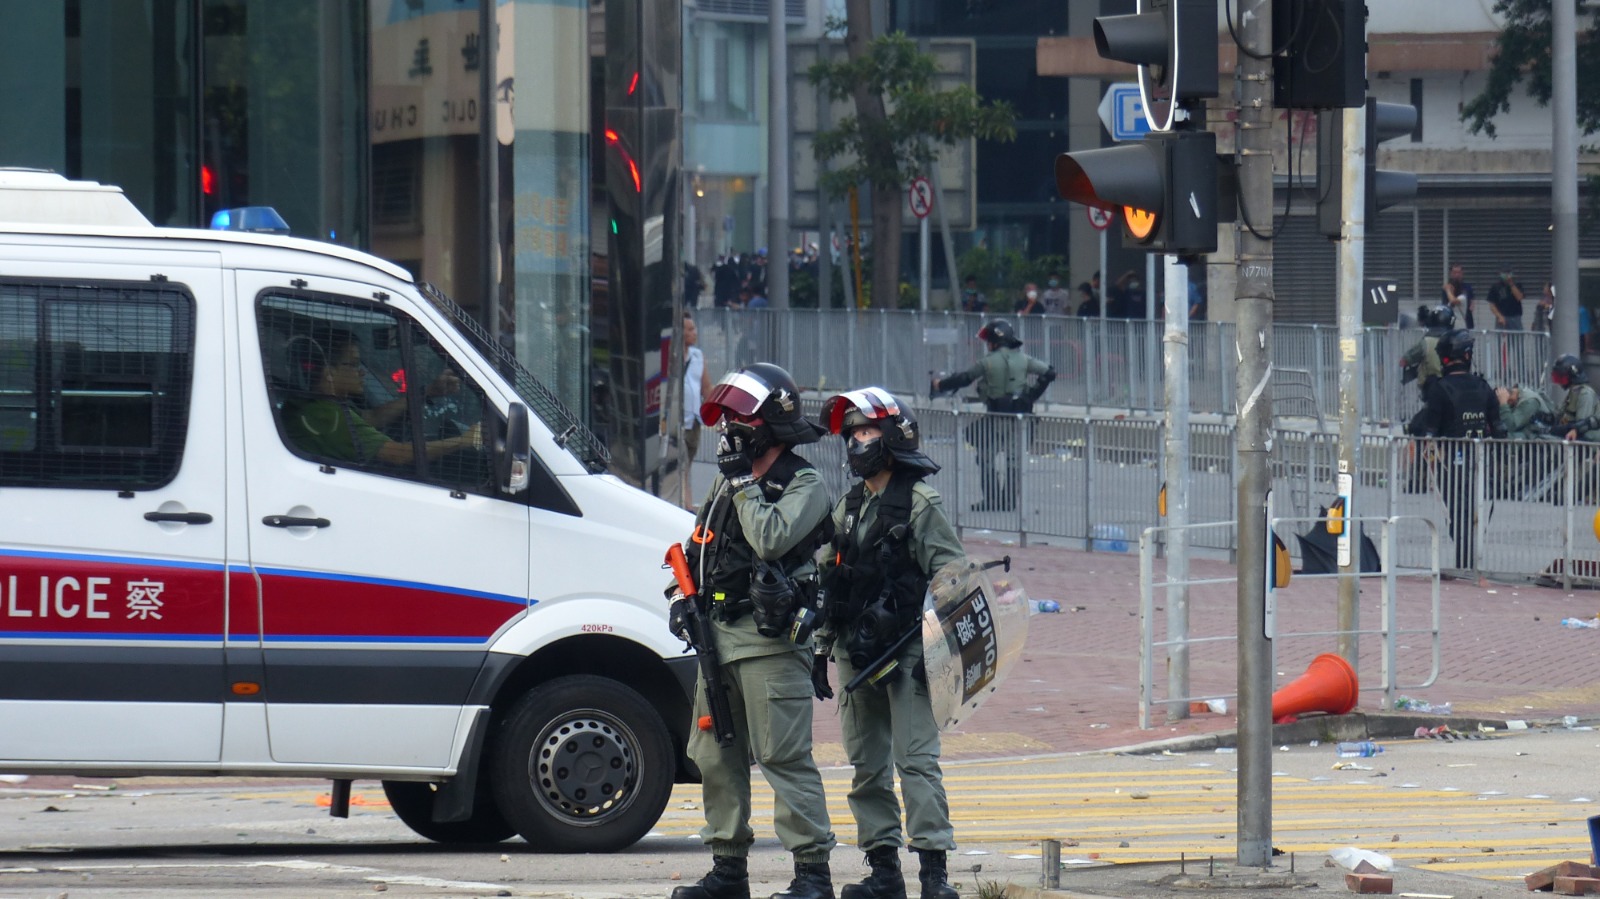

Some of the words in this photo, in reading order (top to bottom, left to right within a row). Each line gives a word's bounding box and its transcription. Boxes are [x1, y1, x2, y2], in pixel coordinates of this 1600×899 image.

[1122, 96, 1147, 132] P
[0, 575, 111, 619] LICE
[126, 577, 164, 620] 察
[581, 624, 613, 632] 420kPa
[970, 593, 997, 681] POLICE
[956, 613, 982, 691] 警察
